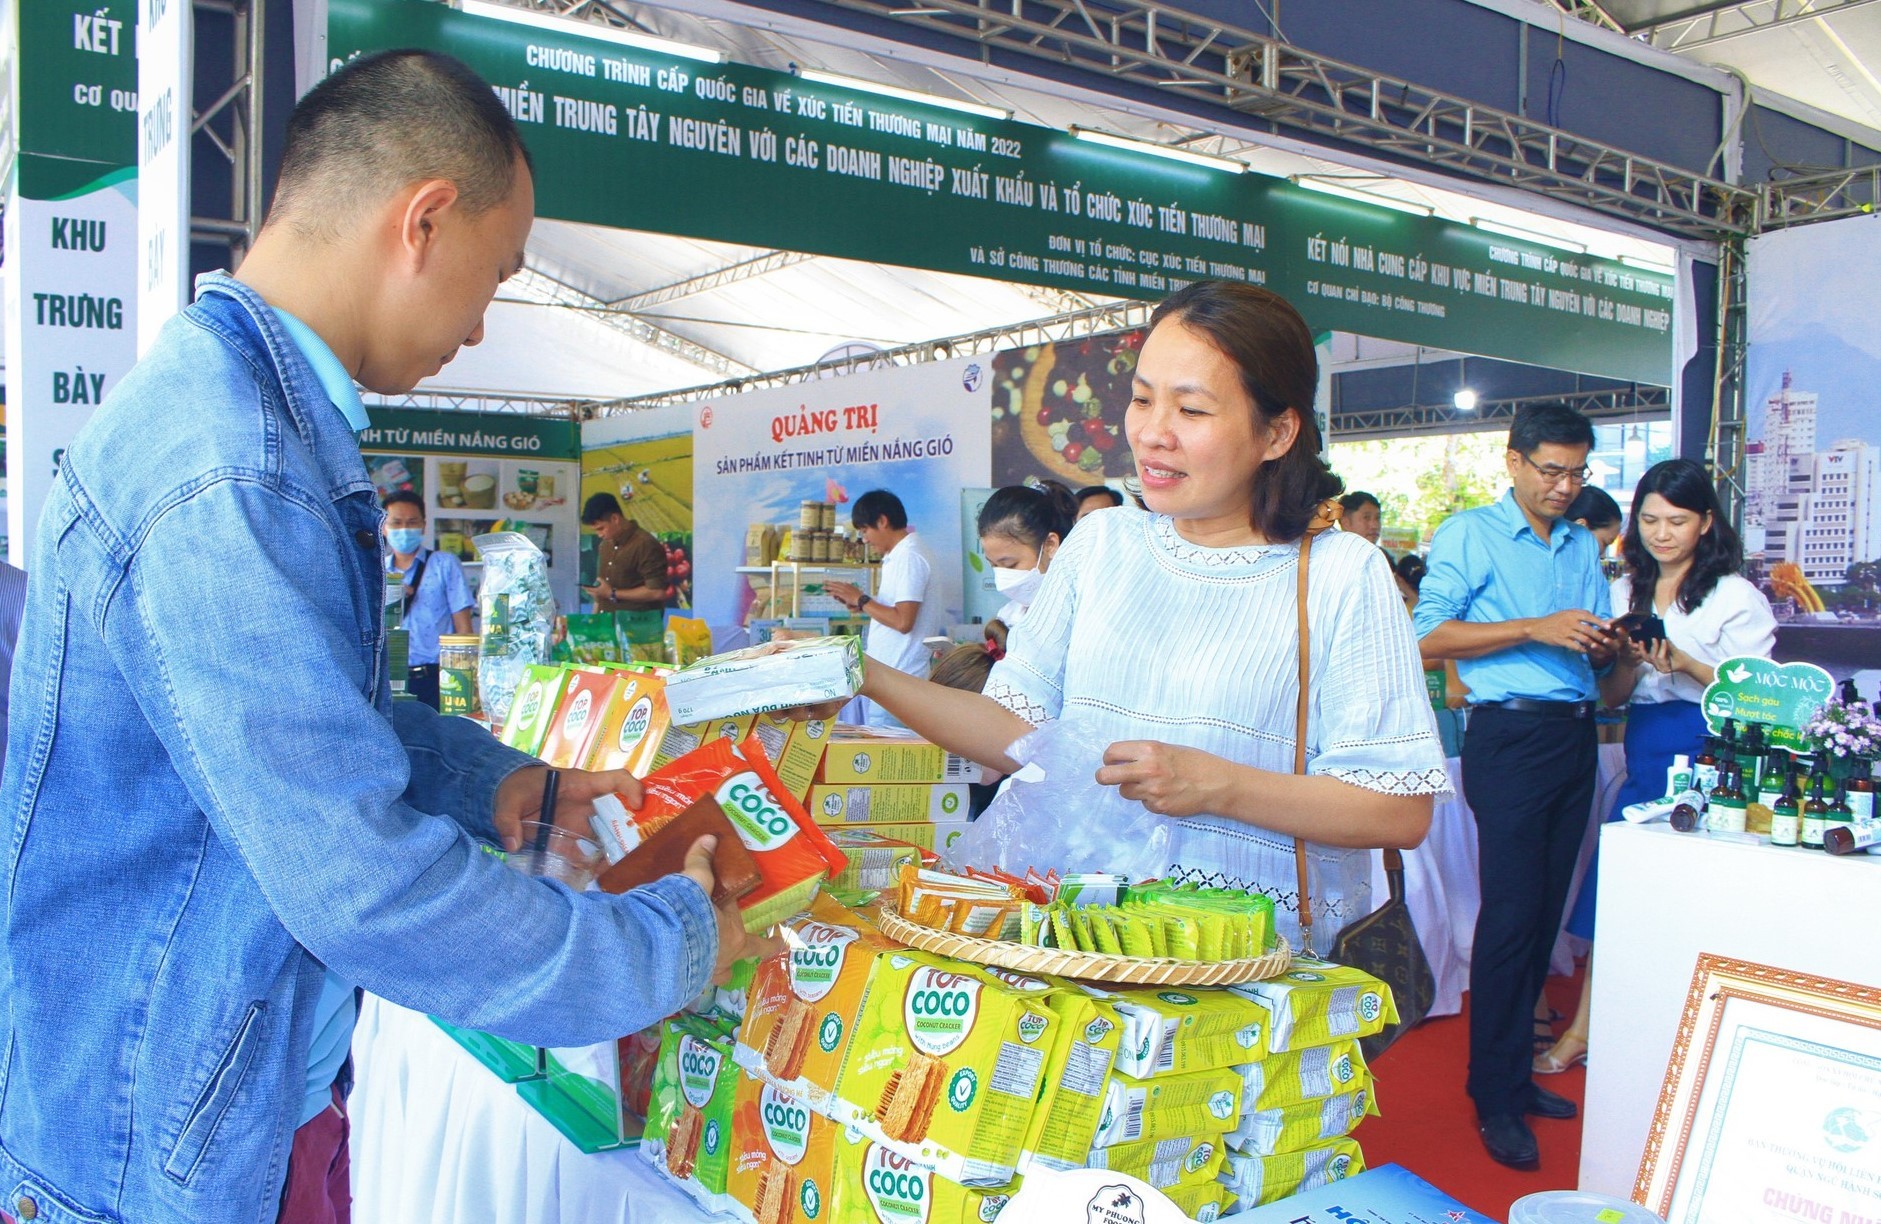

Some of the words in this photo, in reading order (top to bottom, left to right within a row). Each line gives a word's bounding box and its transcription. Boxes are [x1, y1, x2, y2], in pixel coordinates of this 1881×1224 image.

[74, 7, 122, 55] KẾT
[74, 84, 103, 106] CƠ
[110, 89, 139, 112] QU
[526, 44, 595, 77] CHƯƠNG
[602, 58, 651, 88] TRÌNH
[657, 66, 689, 94] CẤP
[695, 75, 736, 103] QUỐC
[742, 86, 768, 109] GIA
[773, 88, 792, 114] VỀ
[797, 95, 826, 121] XÚC
[831, 101, 863, 128] TIẾN
[868, 110, 921, 141] THƯƠNG
[926, 123, 952, 148] MẠI
[956, 128, 987, 152] NĂM
[991, 137, 1022, 159] 2022
[553, 96, 618, 135] TRUNG
[626, 104, 661, 142] TÂY
[669, 116, 741, 157] NGUYÊN
[749, 127, 777, 163] VỚI
[785, 133, 819, 169] CÁC
[827, 143, 881, 181] DOANH
[888, 156, 944, 195] NGHIỆP
[951, 164, 989, 199] XUẤT
[995, 170, 1034, 208] KHẨU
[1039, 182, 1058, 212] VÀ
[1063, 180, 1081, 216] TỔ
[1086, 191, 1121, 223] CHỨC
[1127, 198, 1153, 229] XÚC
[1158, 202, 1186, 235] TIẾN
[1191, 212, 1238, 244] THƯƠNG
[1242, 223, 1266, 253] MẠI
[51, 217, 107, 252] KHU
[970, 246, 985, 264] VÀ
[989, 246, 1005, 267] SỞ
[1008, 252, 1039, 272] CÔNG
[1043, 257, 1085, 279] THƯƠNG
[1088, 263, 1109, 282] CÁC
[1112, 265, 1136, 287] TỈNH
[1139, 271, 1166, 291] MIỀN
[1168, 277, 1197, 292] TRU
[1048, 234, 1071, 252] ĐƠN
[1074, 238, 1086, 258] VỊ
[1089, 236, 1102, 256] TỔ
[1106, 244, 1136, 264] CHỨC:
[1139, 250, 1159, 269] CỤC
[1162, 251, 1182, 270] XÚC
[1185, 255, 1206, 274] TIẾN
[1209, 261, 1245, 281] THƯƠNG
[1248, 268, 1266, 286] MẠI
[1489, 245, 1519, 266] CHƯƠNG
[1520, 251, 1542, 271] TRÌNH
[1543, 255, 1559, 274] CẤP
[1559, 259, 1579, 279] QUỐC
[1580, 266, 1593, 281] GIA
[1307, 231, 1327, 262] KẾT
[1331, 236, 1349, 267] NỐI
[1353, 245, 1374, 272] NHÀ
[1378, 252, 1405, 278] CUNG
[1408, 252, 1428, 282] CẤP
[1431, 263, 1450, 287] KHU
[1453, 268, 1471, 295] VỰC
[1474, 269, 1497, 297] MIỀN
[1500, 278, 1528, 303] TRUNG
[1530, 282, 1546, 307] TÂY
[1548, 288, 1580, 314] NGUYÊN
[1582, 293, 1596, 317] VỚI
[1598, 296, 1614, 320] CÁC
[1616, 303, 1641, 326] DOANH
[1643, 308, 1670, 335] NGHIỆP
[1307, 280, 1319, 294] CƠ
[1321, 283, 1343, 299] QUAN
[1345, 285, 1359, 302] CHỈ
[1381, 293, 1393, 311] BỘ
[1394, 295, 1415, 312] CÔNG
[1417, 301, 1446, 318] THƯƠNG
[33, 292, 123, 330] TRƯNG
[52, 365, 107, 405] BÀY
[384, 427, 410, 444] TỪ
[412, 428, 455, 447] MIỀN
[458, 430, 507, 449] NẮNG
[511, 434, 541, 450] GIÓ
[771, 403, 839, 443] QUẢNG
[843, 403, 879, 434] TRỊ
[716, 455, 738, 475] SẢN
[739, 451, 771, 473] PHẨM
[773, 448, 794, 469] KẾT
[796, 451, 824, 468] TINH
[826, 445, 844, 466] TỪ
[847, 440, 879, 463] MIỀN
[882, 436, 924, 460] NẮNG
[926, 433, 954, 456] GIÓ
[1755, 671, 1789, 688] MỘC
[1791, 675, 1826, 692] MỘC
[573, 698, 588, 711] TOP
[631, 708, 648, 720] TOP
[1737, 692, 1760, 705] Sạch
[567, 709, 588, 724] COCO
[623, 720, 647, 733] COCO
[729, 783, 789, 836] COCO
[911, 990, 970, 1017] COCO
[916, 1020, 939, 1029] COCONUT
[939, 1021, 961, 1030] CRACKER
[682, 1052, 716, 1077] COCO
[959, 1070, 976, 1082] EXPORT
[764, 1102, 806, 1132] COCO
[950, 1096, 968, 1109] QUALITY
[869, 1169, 924, 1201] COCO
[1091, 1204, 1104, 1214] MY
[1762, 1187, 1834, 1224] CHỨNG
